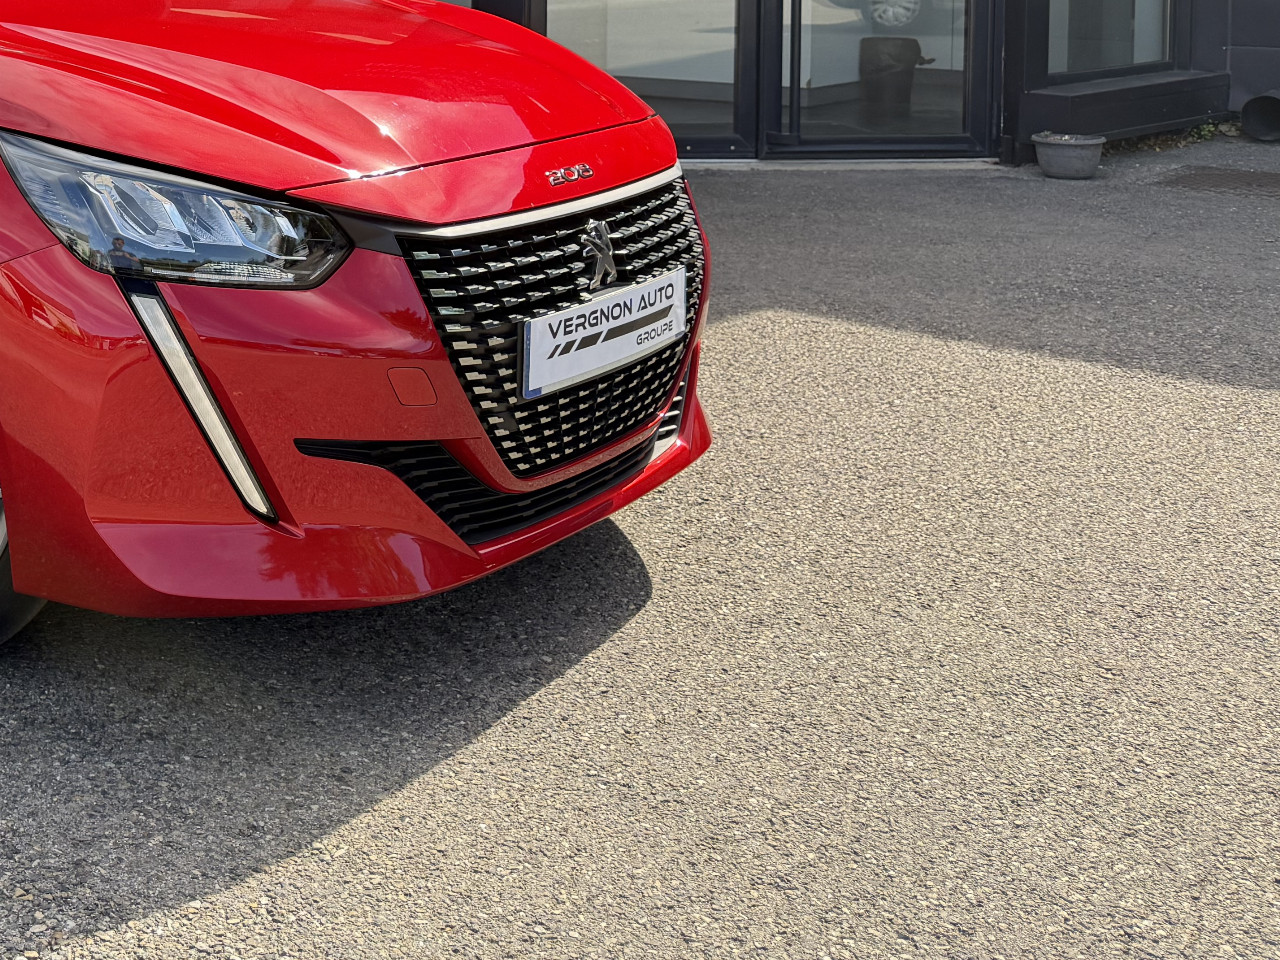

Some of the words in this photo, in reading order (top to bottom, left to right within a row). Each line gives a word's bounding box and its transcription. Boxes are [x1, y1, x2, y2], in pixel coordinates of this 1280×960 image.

[545, 163, 594, 187] 208
[548, 298, 633, 340] VERGNON
[637, 282, 675, 313] AUTO
[636, 320, 674, 346] GROUPE
